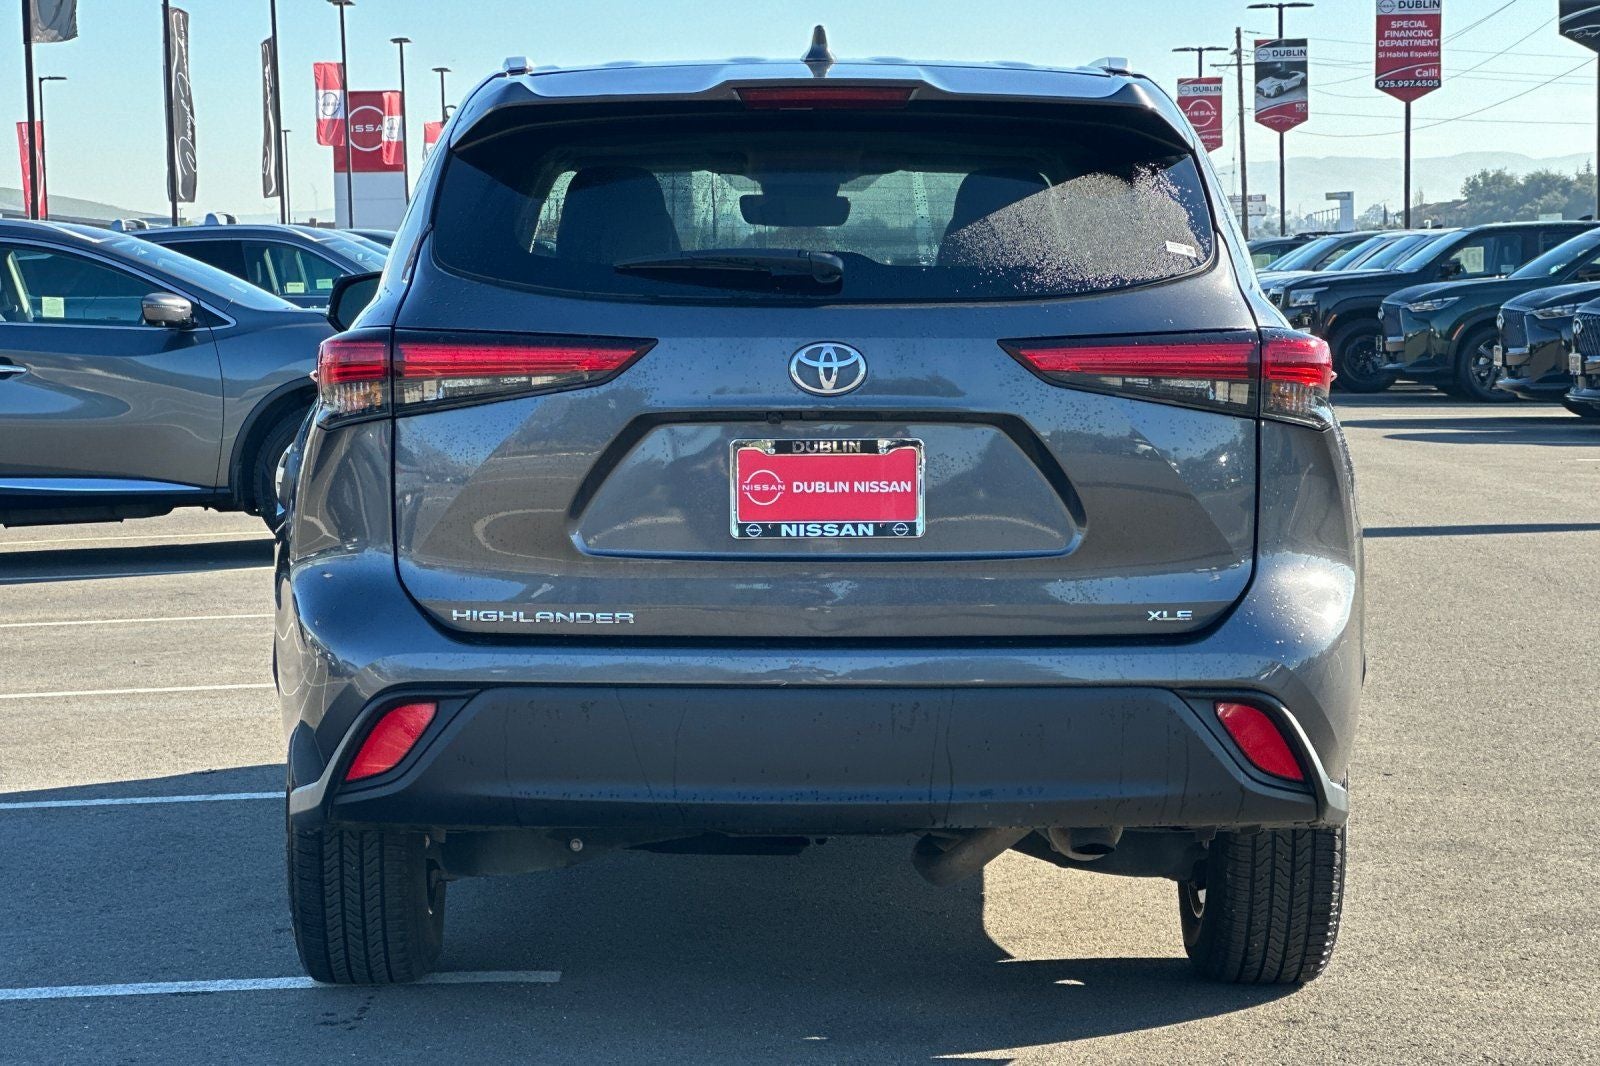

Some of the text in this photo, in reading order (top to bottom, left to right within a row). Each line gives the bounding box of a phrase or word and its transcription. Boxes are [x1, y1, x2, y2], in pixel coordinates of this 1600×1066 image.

[1398, 0, 1440, 9] DUBLIN
[1390, 20, 1428, 28] SPECIAL
[1384, 29, 1434, 38] FINANCING
[1378, 38, 1440, 47] DEPARTMENT
[1272, 49, 1306, 57] DUBLIN
[1410, 50, 1439, 58] Español
[1415, 68, 1438, 77] Call!
[1378, 80, 1439, 88] 925.997.4505
[1192, 85, 1222, 93] DUBLIN
[351, 124, 383, 133] ISSA
[792, 440, 861, 453] DUBLIN
[742, 484, 786, 492] NISSAN
[792, 480, 912, 493] DUBLIN NISSAN
[780, 523, 874, 537] NISSAN
[452, 609, 635, 624] HIGHLANDER
[1147, 610, 1193, 621] XLE
